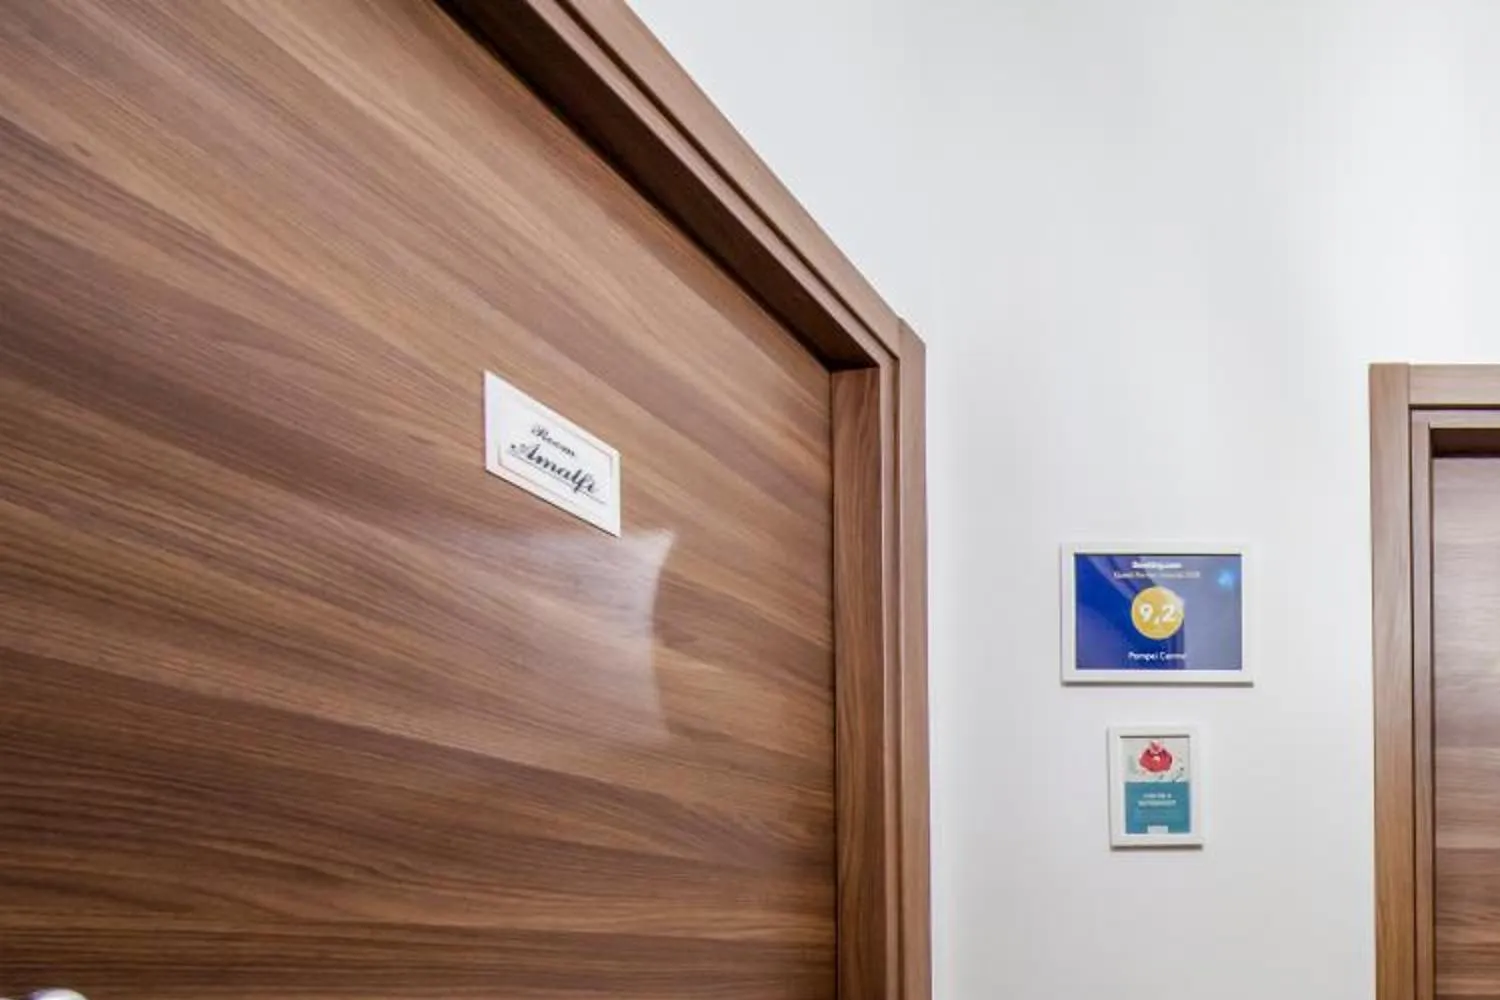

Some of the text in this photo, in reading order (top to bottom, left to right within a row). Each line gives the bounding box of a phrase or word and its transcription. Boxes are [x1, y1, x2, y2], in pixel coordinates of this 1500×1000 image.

[530, 424, 576, 457] Room
[509, 443, 600, 494] Amalfi
[1139, 602, 1176, 626] 9,2
